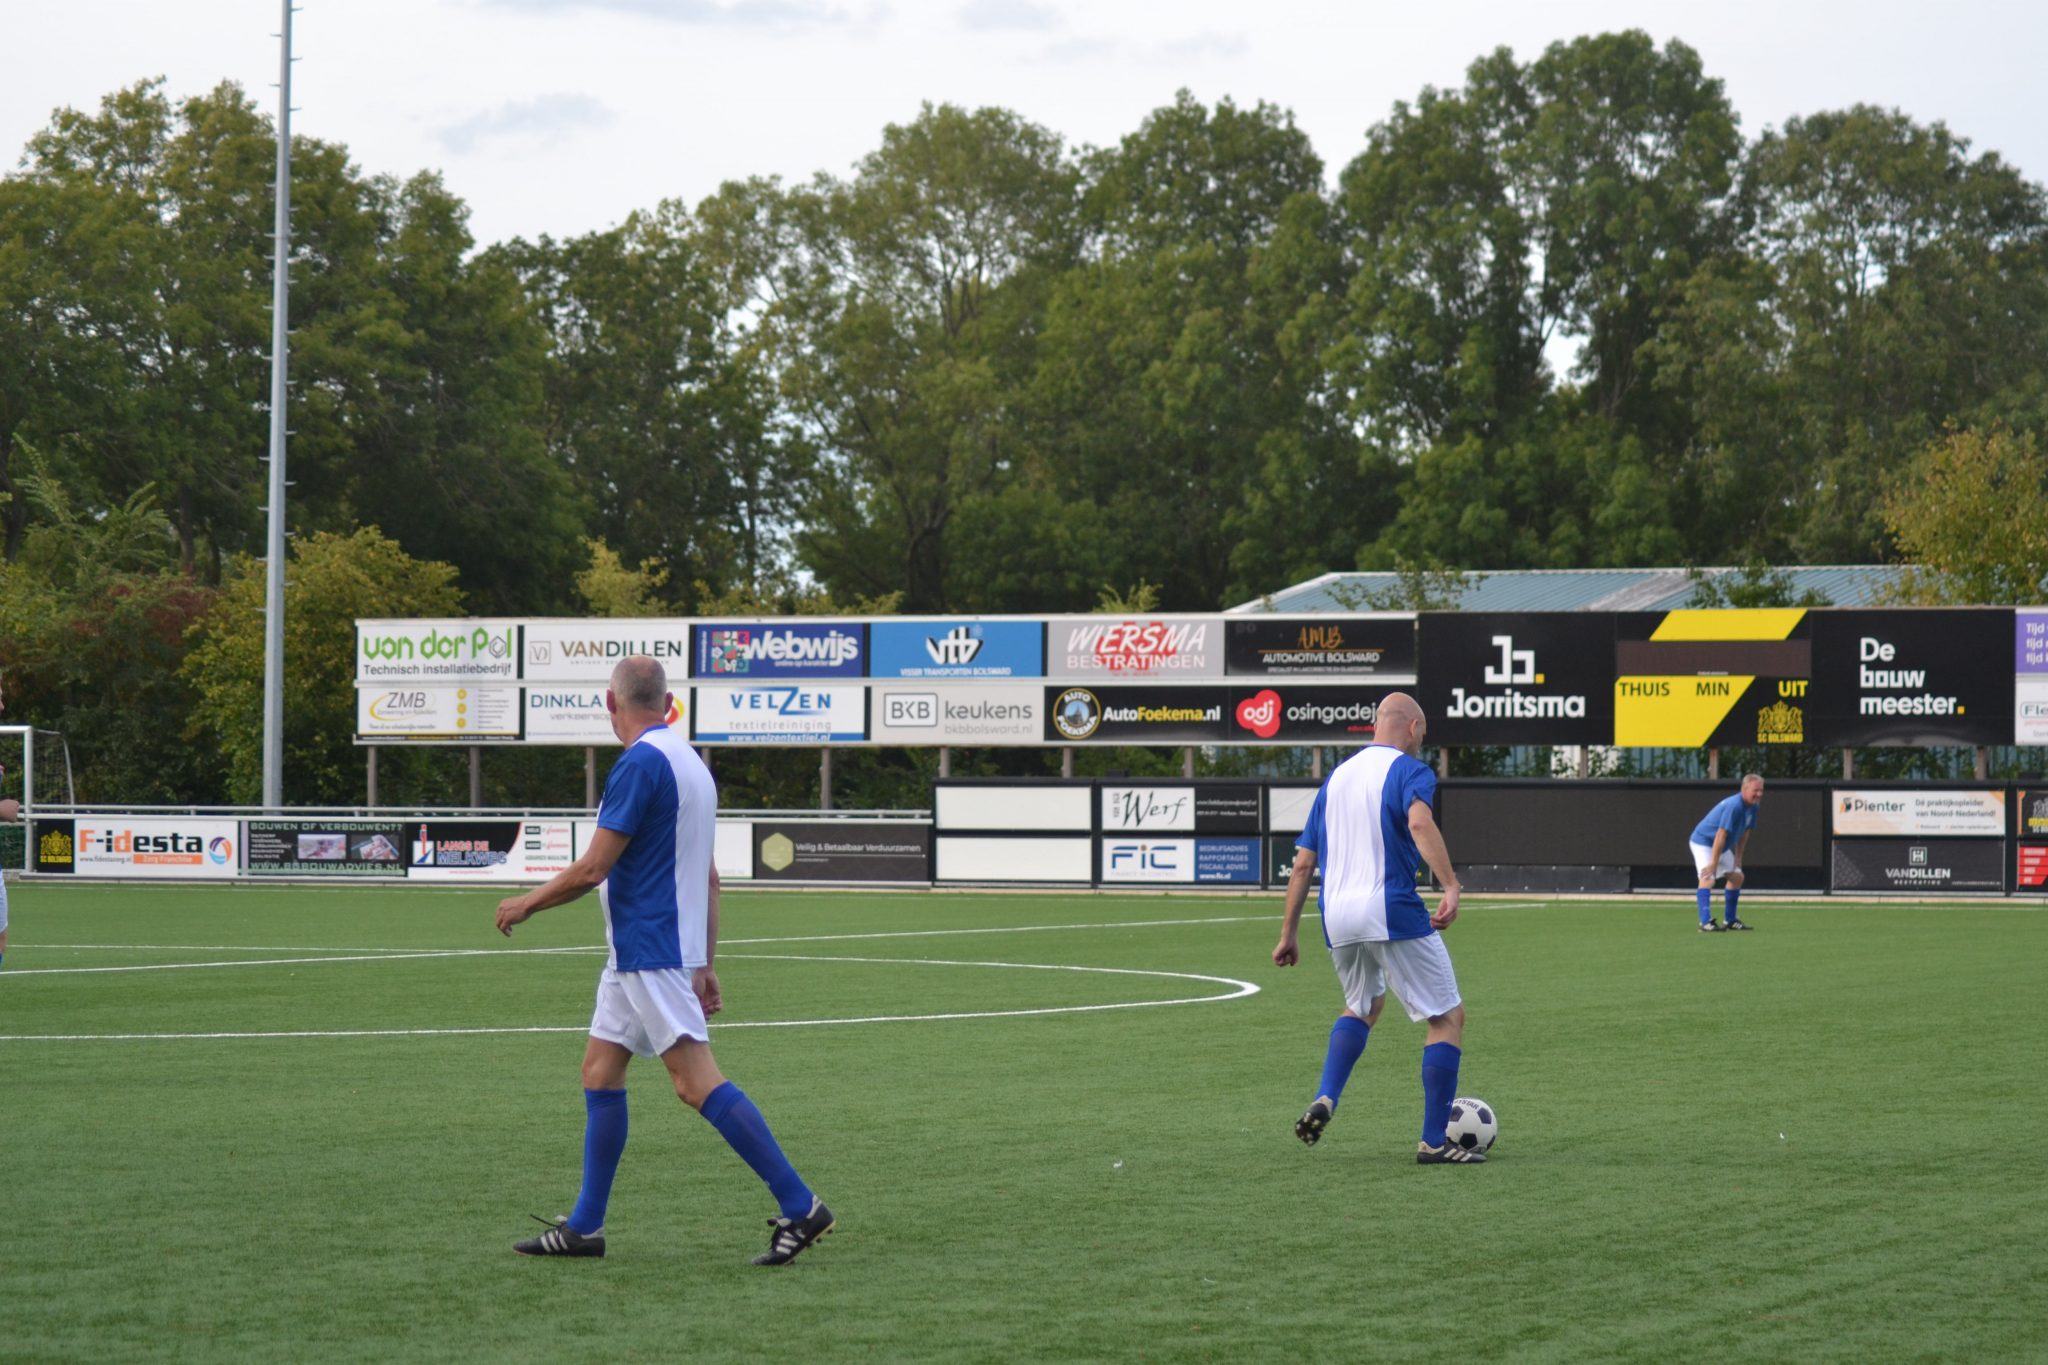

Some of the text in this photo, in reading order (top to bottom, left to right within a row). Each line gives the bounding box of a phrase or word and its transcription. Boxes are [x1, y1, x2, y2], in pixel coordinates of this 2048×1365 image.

[1067, 624, 1207, 654] WIERSMA
[560, 640, 683, 657] VANDILLEN
[748, 630, 859, 667] Webwijs
[1860, 637, 1896, 661] De
[1067, 654, 1206, 669] BESTRATINGEN
[1262, 653, 1380, 663] AUTOMOTIVE BOLSWARD
[363, 663, 512, 677] Technisch installatiebedrijf
[1860, 664, 1925, 688] bouw
[1064, 691, 1091, 703] AUTO
[1619, 680, 1809, 697] THUIS MIN UIT
[387, 692, 427, 708] ZMB
[531, 694, 602, 708] DINKLA
[730, 687, 832, 715] VELZEN
[1447, 688, 1586, 718] Jorritsma
[1860, 693, 1966, 715] meester.
[945, 700, 1033, 719] keukens
[1103, 706, 1221, 721] AutoFoekema.nl
[1243, 699, 1274, 727] odj
[1287, 702, 1377, 725] osingadej
[1057, 715, 1098, 735] FOEKEMA
[1122, 790, 1188, 827] Werf
[1854, 799, 1906, 813] Pienter
[250, 822, 298, 831] BOUWEN
[79, 829, 203, 853] F-idesta
[437, 851, 508, 865] MELKWEG
[1886, 868, 1951, 878] VANDILLEN
